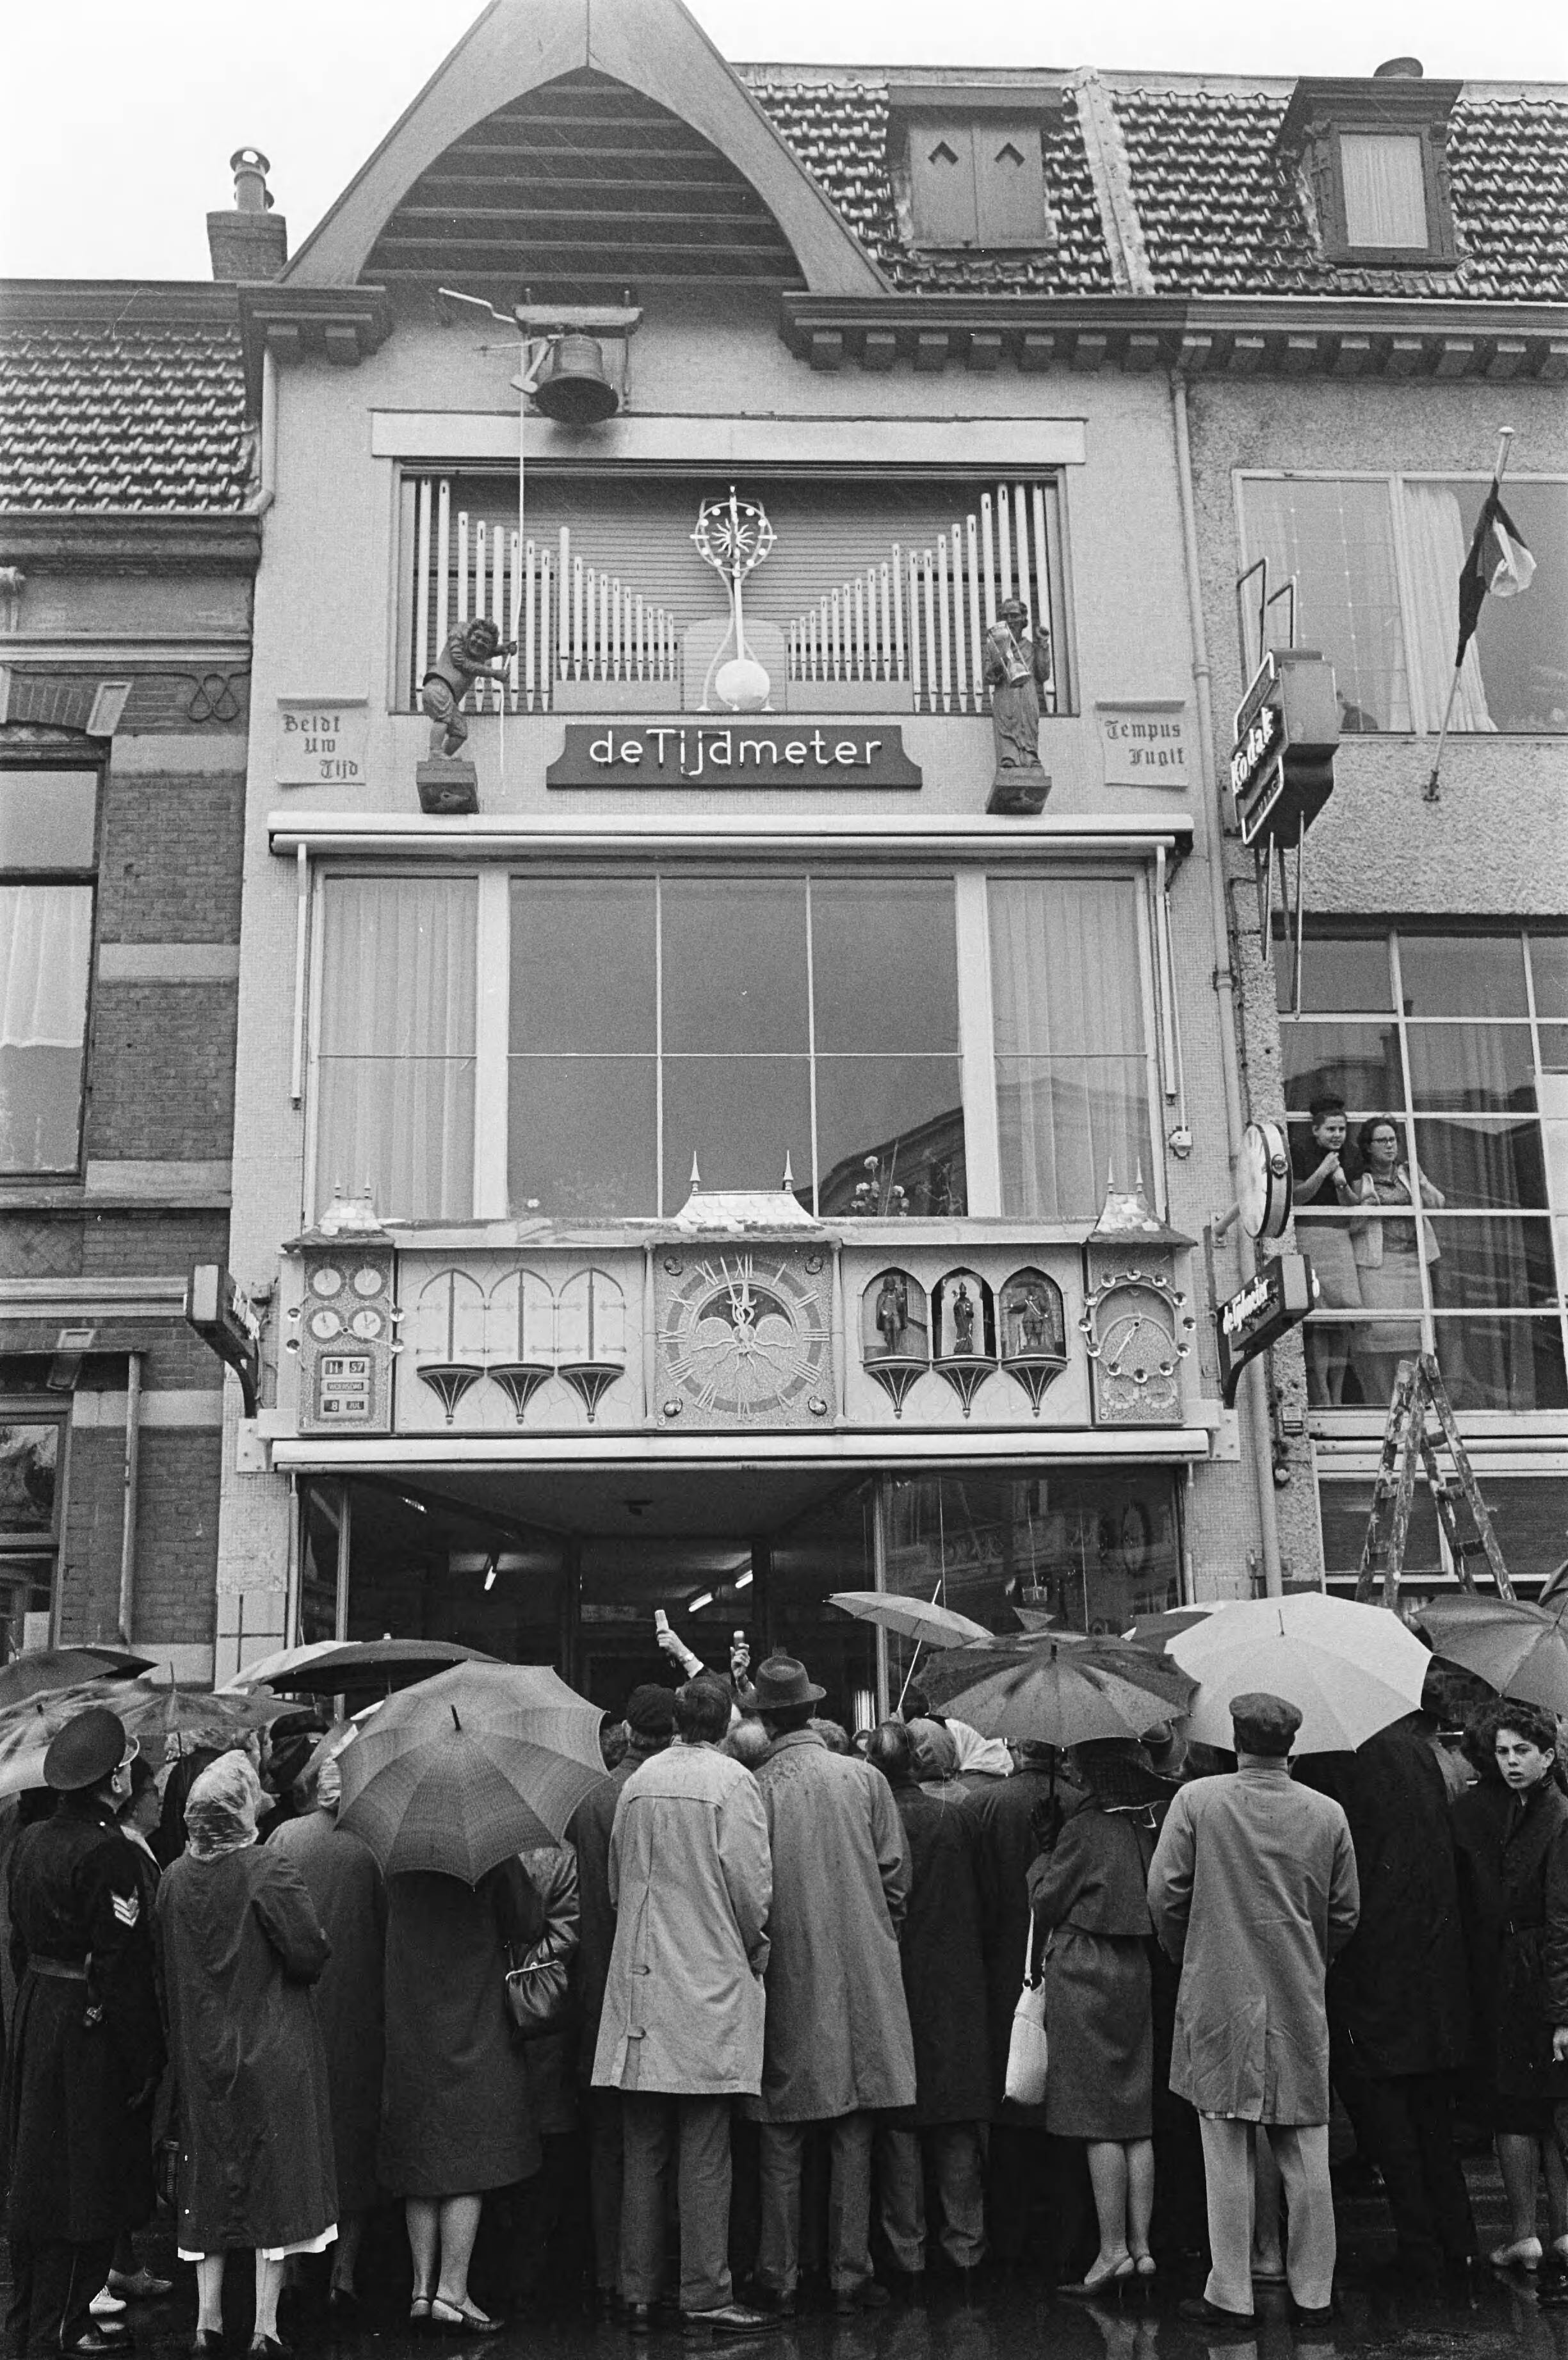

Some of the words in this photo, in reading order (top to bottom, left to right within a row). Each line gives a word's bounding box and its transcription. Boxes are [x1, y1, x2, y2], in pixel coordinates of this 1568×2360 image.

[283, 713, 341, 733] Beidt
[1104, 720, 1181, 742] Tempus
[1129, 747, 1184, 767] Fugit
[1230, 706, 1273, 795] Kodak
[319, 760, 359, 780] Tijd
[331, 1401, 337, 1411] 8
